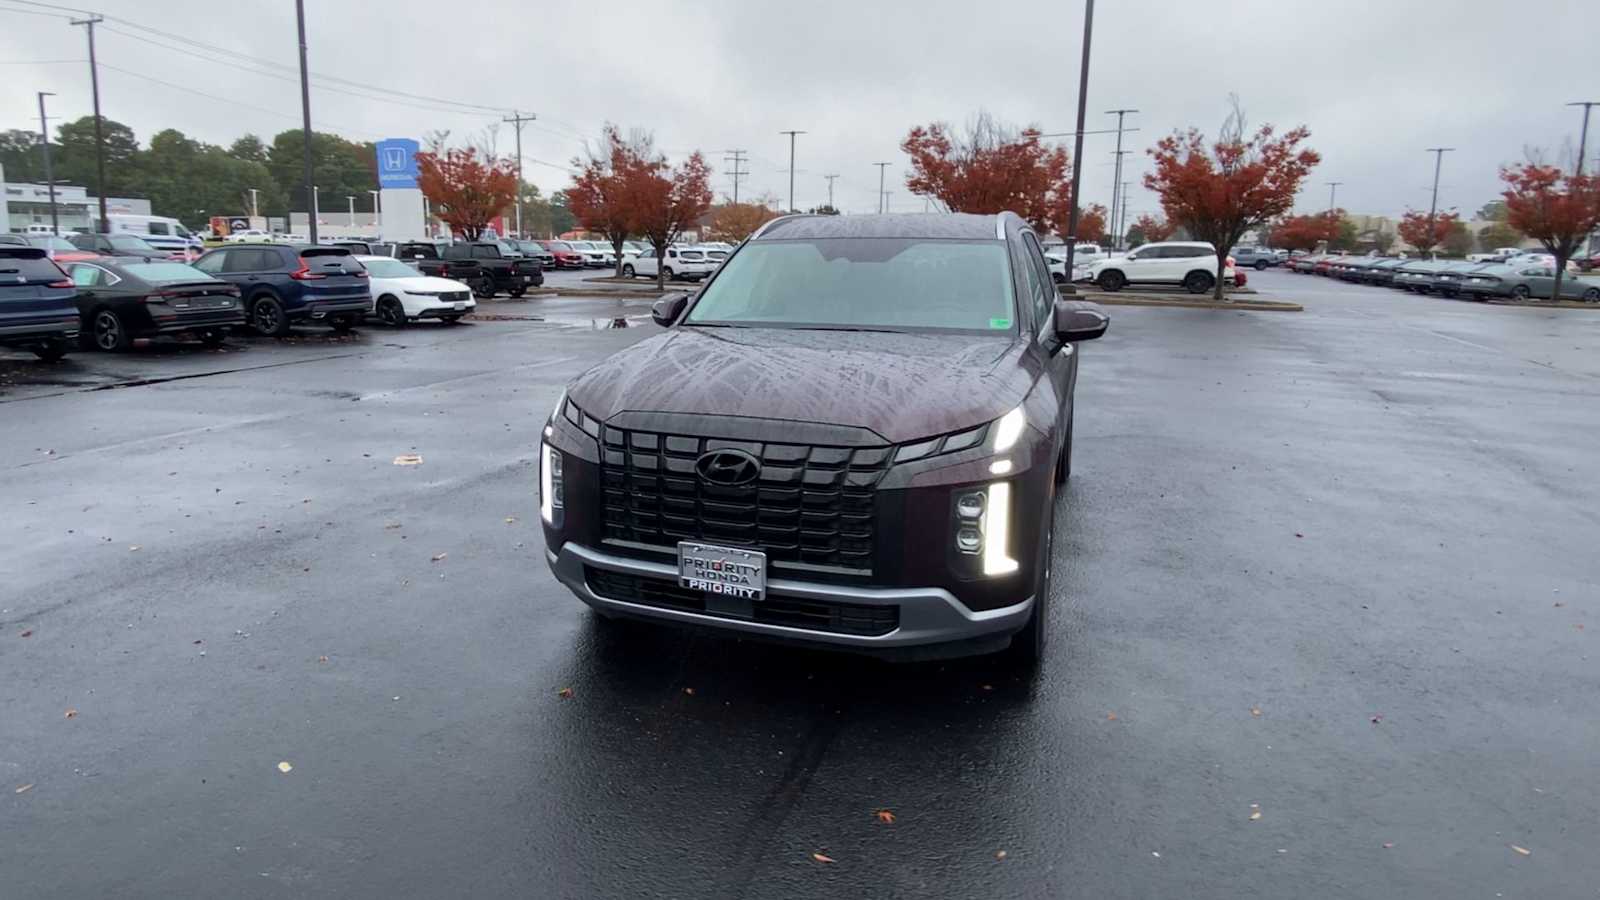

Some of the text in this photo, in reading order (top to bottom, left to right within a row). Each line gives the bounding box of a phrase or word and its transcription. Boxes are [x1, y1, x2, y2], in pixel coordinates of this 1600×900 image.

[684, 557, 760, 576] PRIORITY
[696, 569, 750, 585] HONDA
[689, 580, 754, 598] PRIORITY
